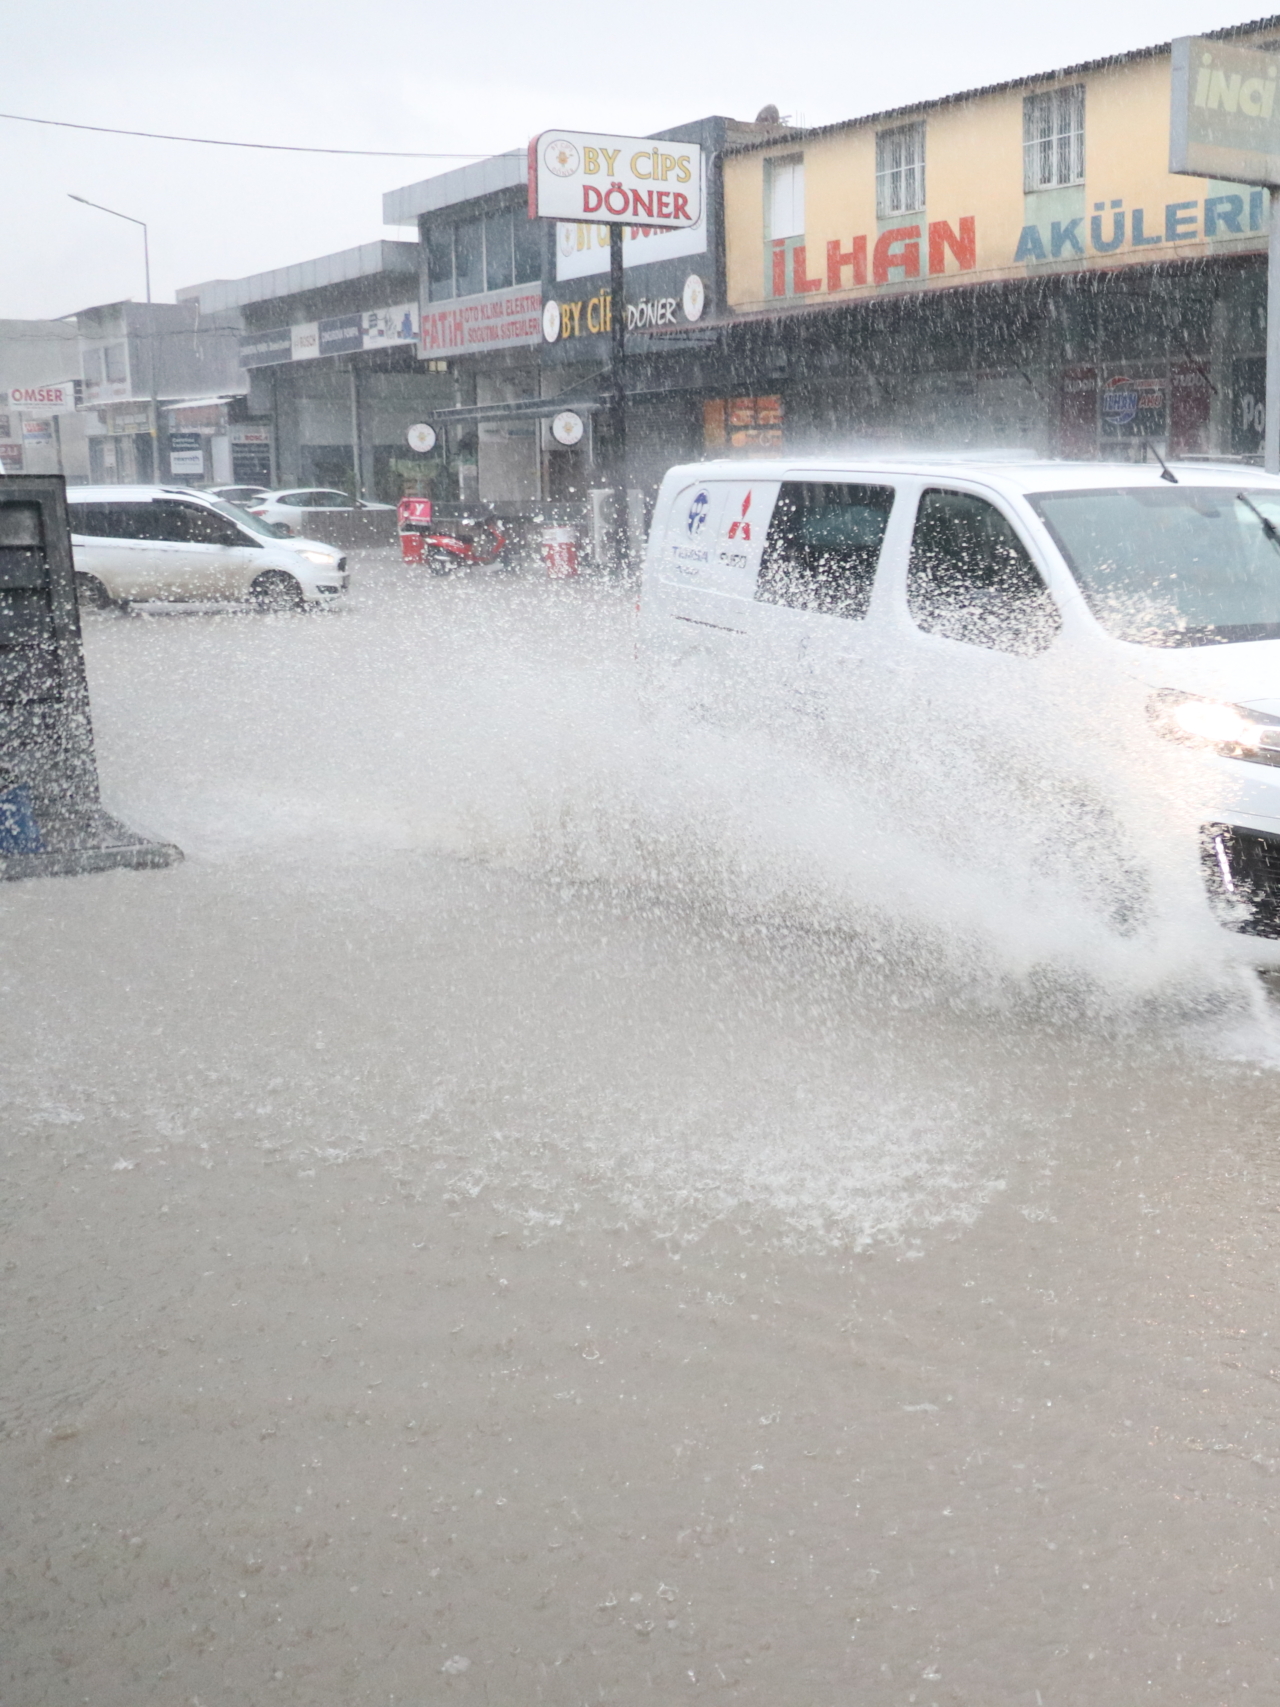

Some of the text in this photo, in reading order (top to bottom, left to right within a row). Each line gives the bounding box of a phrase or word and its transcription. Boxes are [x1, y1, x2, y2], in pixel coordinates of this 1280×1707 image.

[1194, 53, 1277, 118] İNCİ
[583, 146, 691, 183] BY CİPS
[582, 182, 693, 220] DÖNER
[772, 215, 976, 296] İLHAN
[562, 301, 582, 338] BY
[627, 298, 677, 330] DÖNER
[11, 389, 63, 402] OMSER
